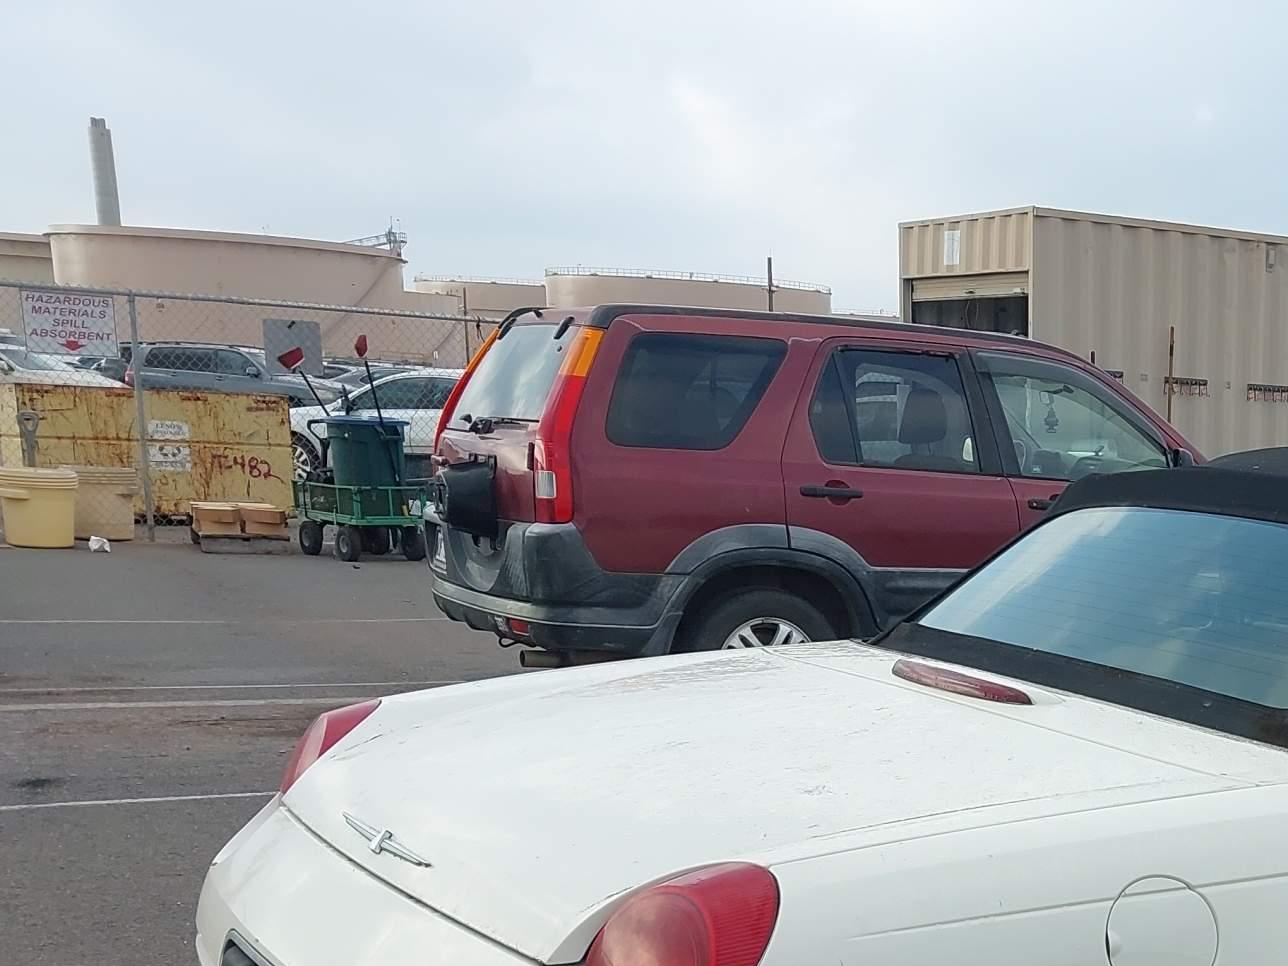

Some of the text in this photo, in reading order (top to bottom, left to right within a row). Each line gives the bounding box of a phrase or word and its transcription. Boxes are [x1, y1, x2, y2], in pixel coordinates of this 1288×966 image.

[25, 293, 109, 308] HAZARDOUS
[31, 305, 107, 319] MATERIALS
[52, 318, 89, 329] SPILL
[29, 328, 112, 341] ABSORBENT
